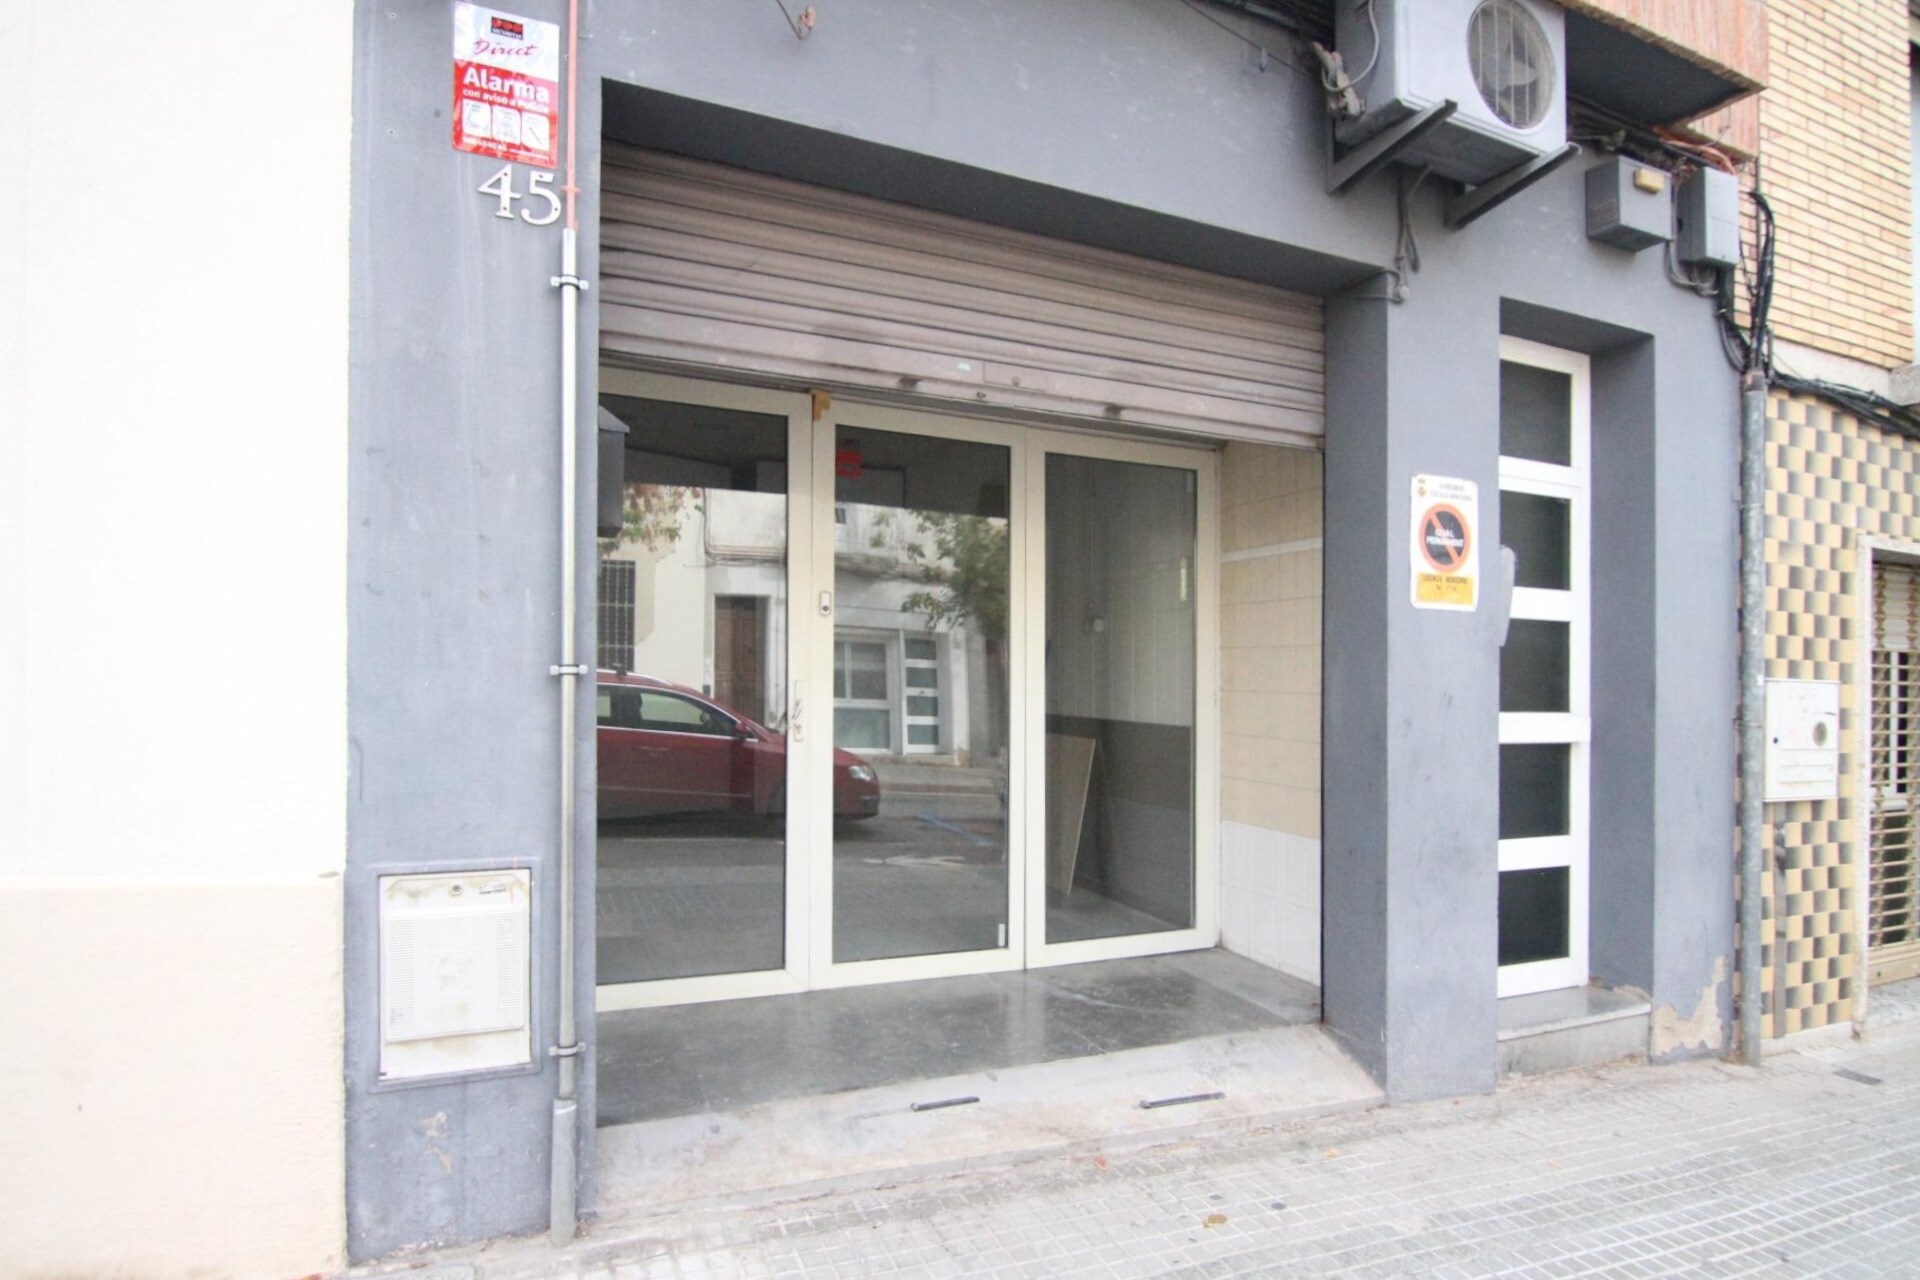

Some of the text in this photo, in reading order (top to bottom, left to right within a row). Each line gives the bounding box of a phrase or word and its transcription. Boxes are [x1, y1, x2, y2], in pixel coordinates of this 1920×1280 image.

[473, 38, 539, 56] Direct
[462, 88, 481, 99] con
[482, 91, 508, 105] aviso
[463, 66, 550, 102] Alarma
[477, 163, 562, 226] 45
